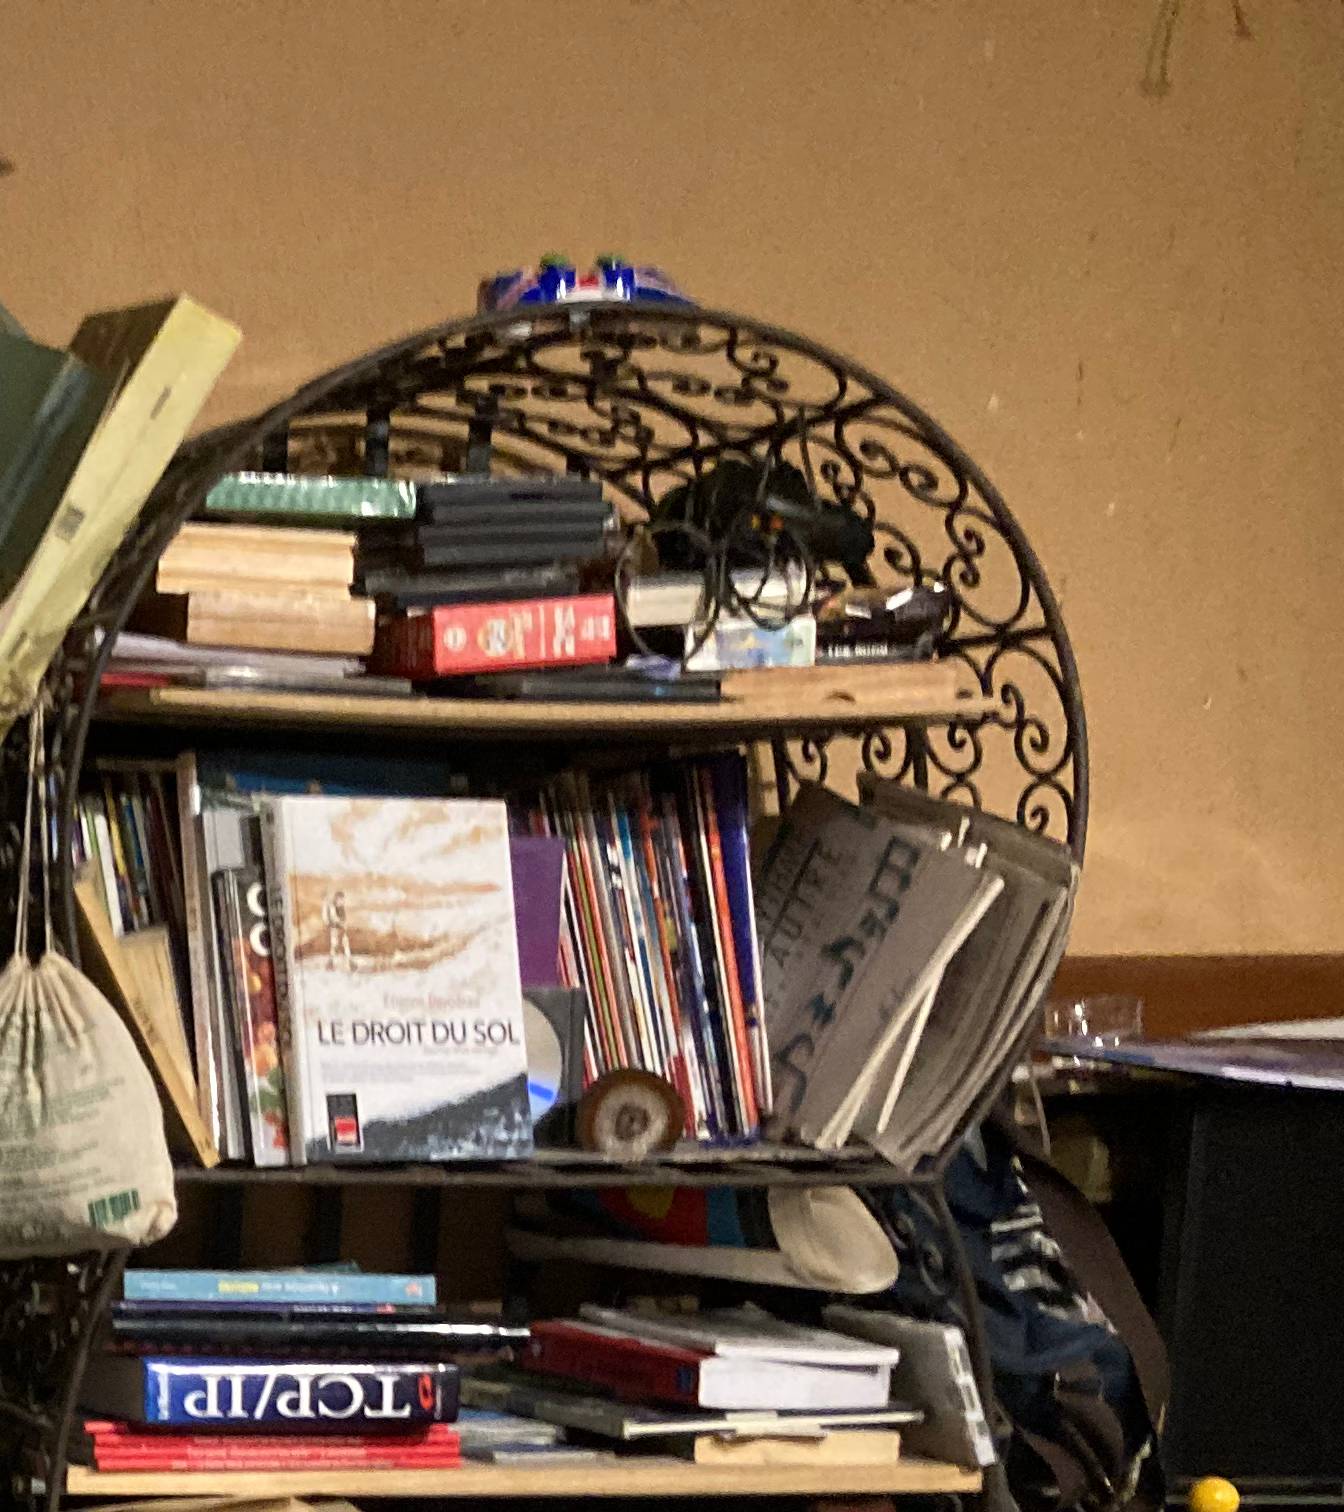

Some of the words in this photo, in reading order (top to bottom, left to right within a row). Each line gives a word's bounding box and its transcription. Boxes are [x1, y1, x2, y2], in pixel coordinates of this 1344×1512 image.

[317, 1019, 345, 1045] LE
[351, 1019, 427, 1046] DROIT
[431, 1020, 467, 1045] DU
[473, 1019, 521, 1046] SOL
[183, 1373, 412, 1420] TCP/IP
